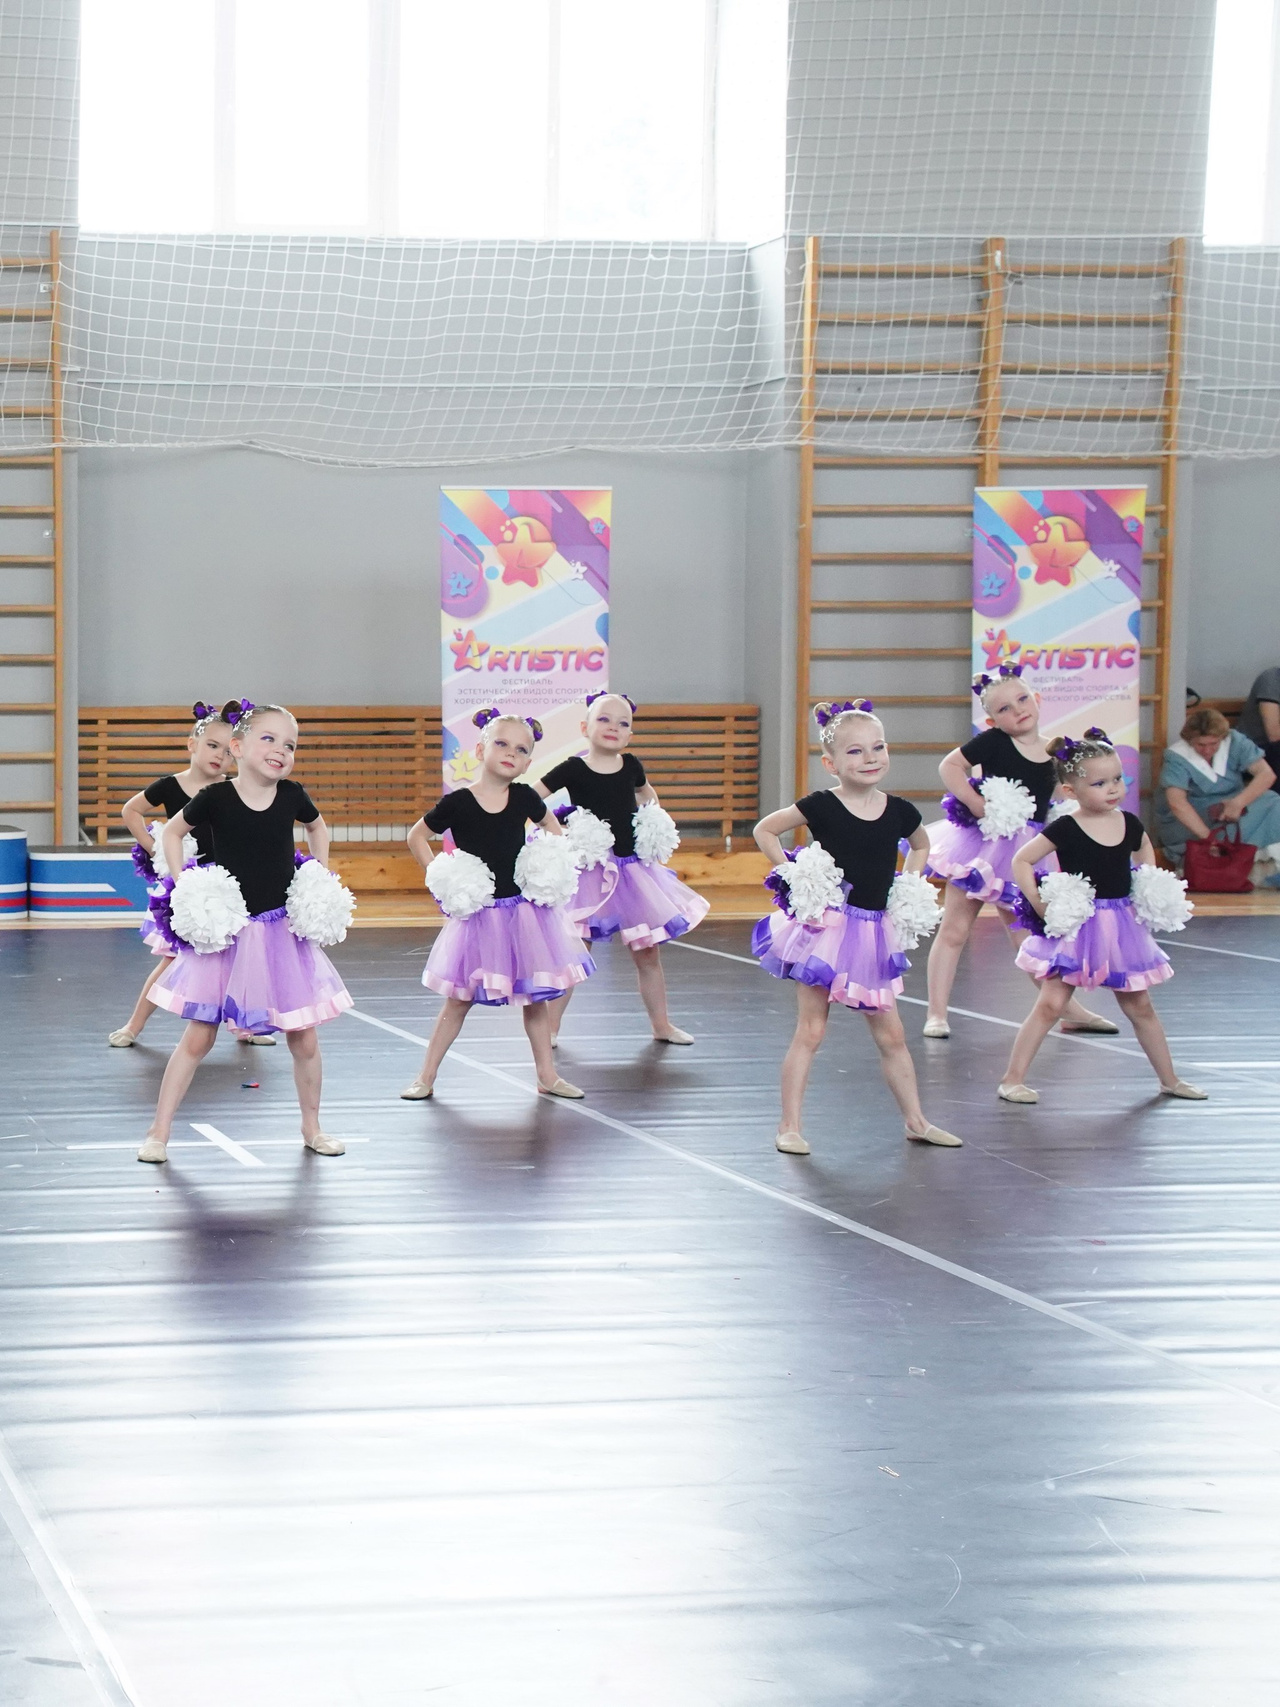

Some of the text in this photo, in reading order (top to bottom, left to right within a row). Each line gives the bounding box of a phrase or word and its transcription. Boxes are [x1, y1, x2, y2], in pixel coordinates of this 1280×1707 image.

[450, 629, 605, 672] ARTISTIC
[981, 629, 1136, 671] ARTISTIC
[501, 678, 553, 686] ФЕСТИВАЛЬ
